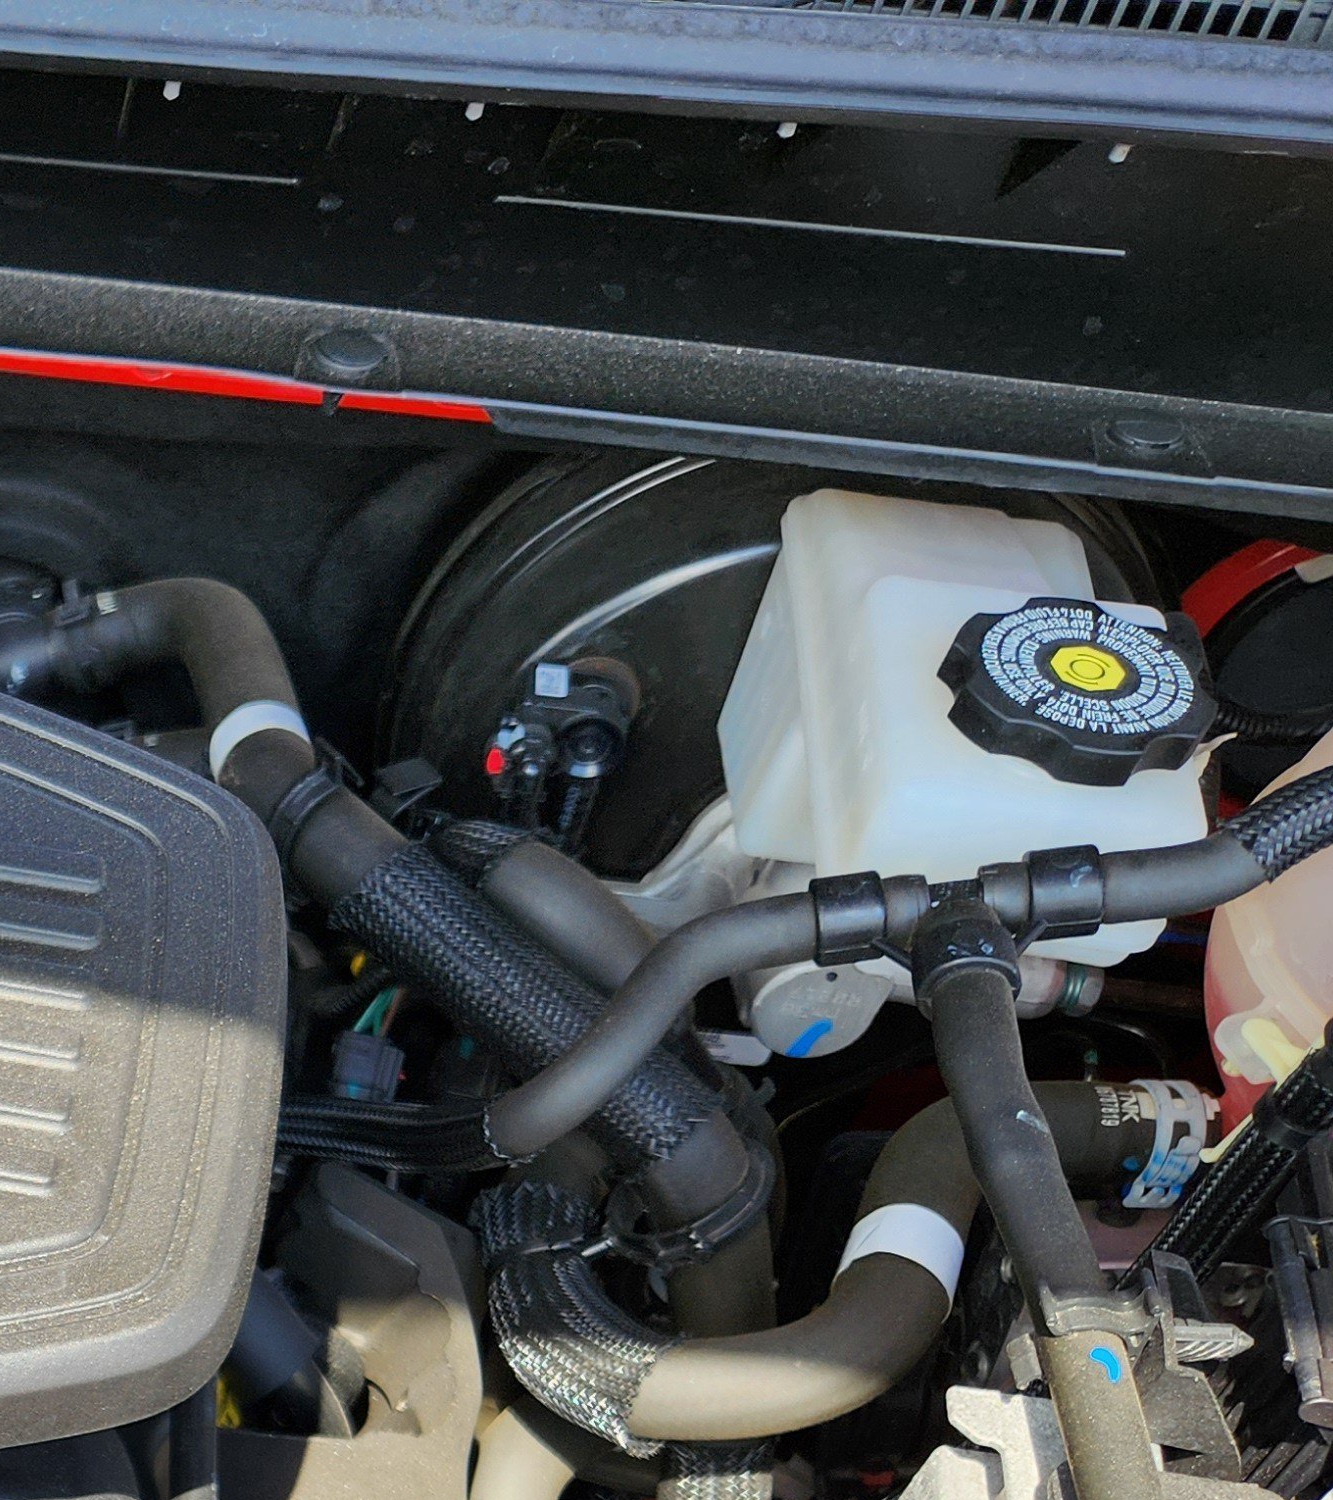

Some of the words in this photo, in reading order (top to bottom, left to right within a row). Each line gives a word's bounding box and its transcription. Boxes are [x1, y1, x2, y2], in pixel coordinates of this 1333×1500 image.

[1068, 616, 1094, 631] CAP
[1097, 614, 1163, 650] ATTENTION:
[1011, 678, 1048, 700] ONLY
[1174, 688, 1193, 702] LE
[1081, 708, 1124, 723] FREIN
[1119, 708, 1143, 723] DE
[1088, 719, 1107, 733] LA
[1110, 719, 1153, 734] AVANT
[1116, 1088, 1139, 1122] TNK
